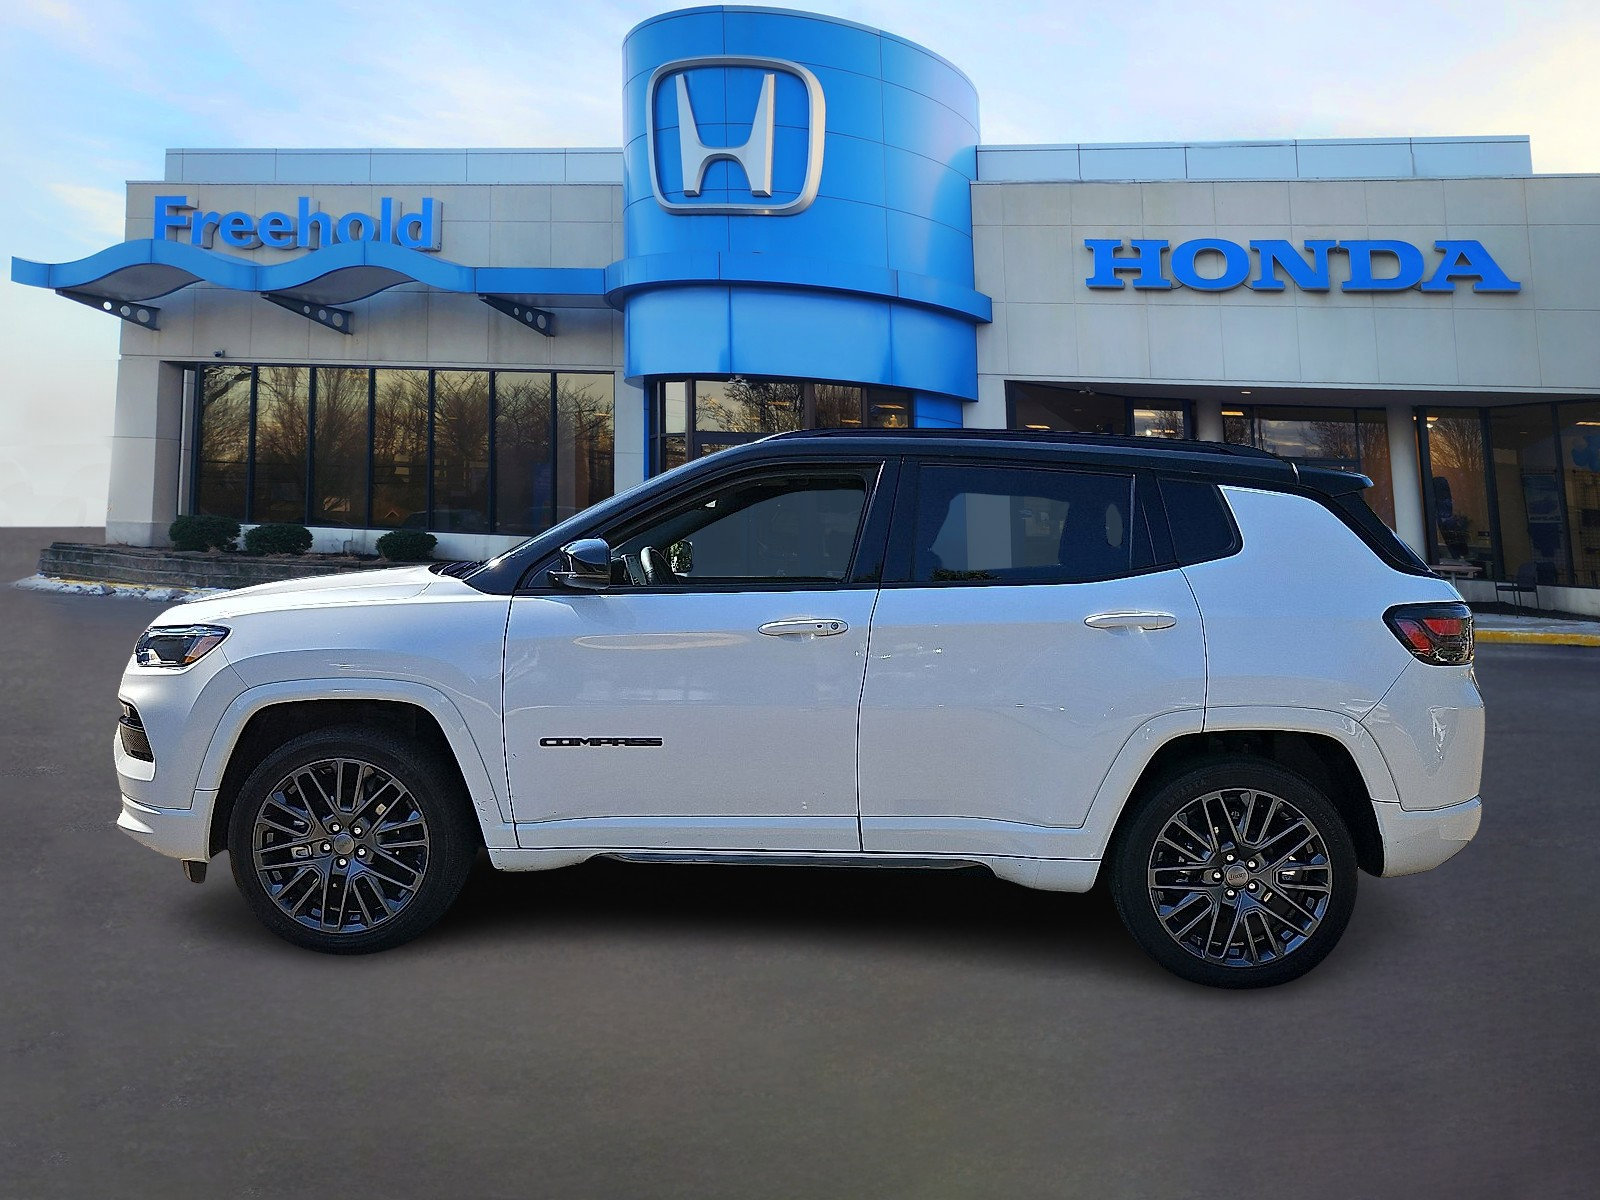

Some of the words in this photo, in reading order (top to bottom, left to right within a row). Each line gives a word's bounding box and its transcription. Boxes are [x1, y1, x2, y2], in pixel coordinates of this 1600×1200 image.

[154, 195, 442, 251] Freehold
[1084, 238, 1521, 293] HONDA
[539, 737, 663, 747] COMPASS
